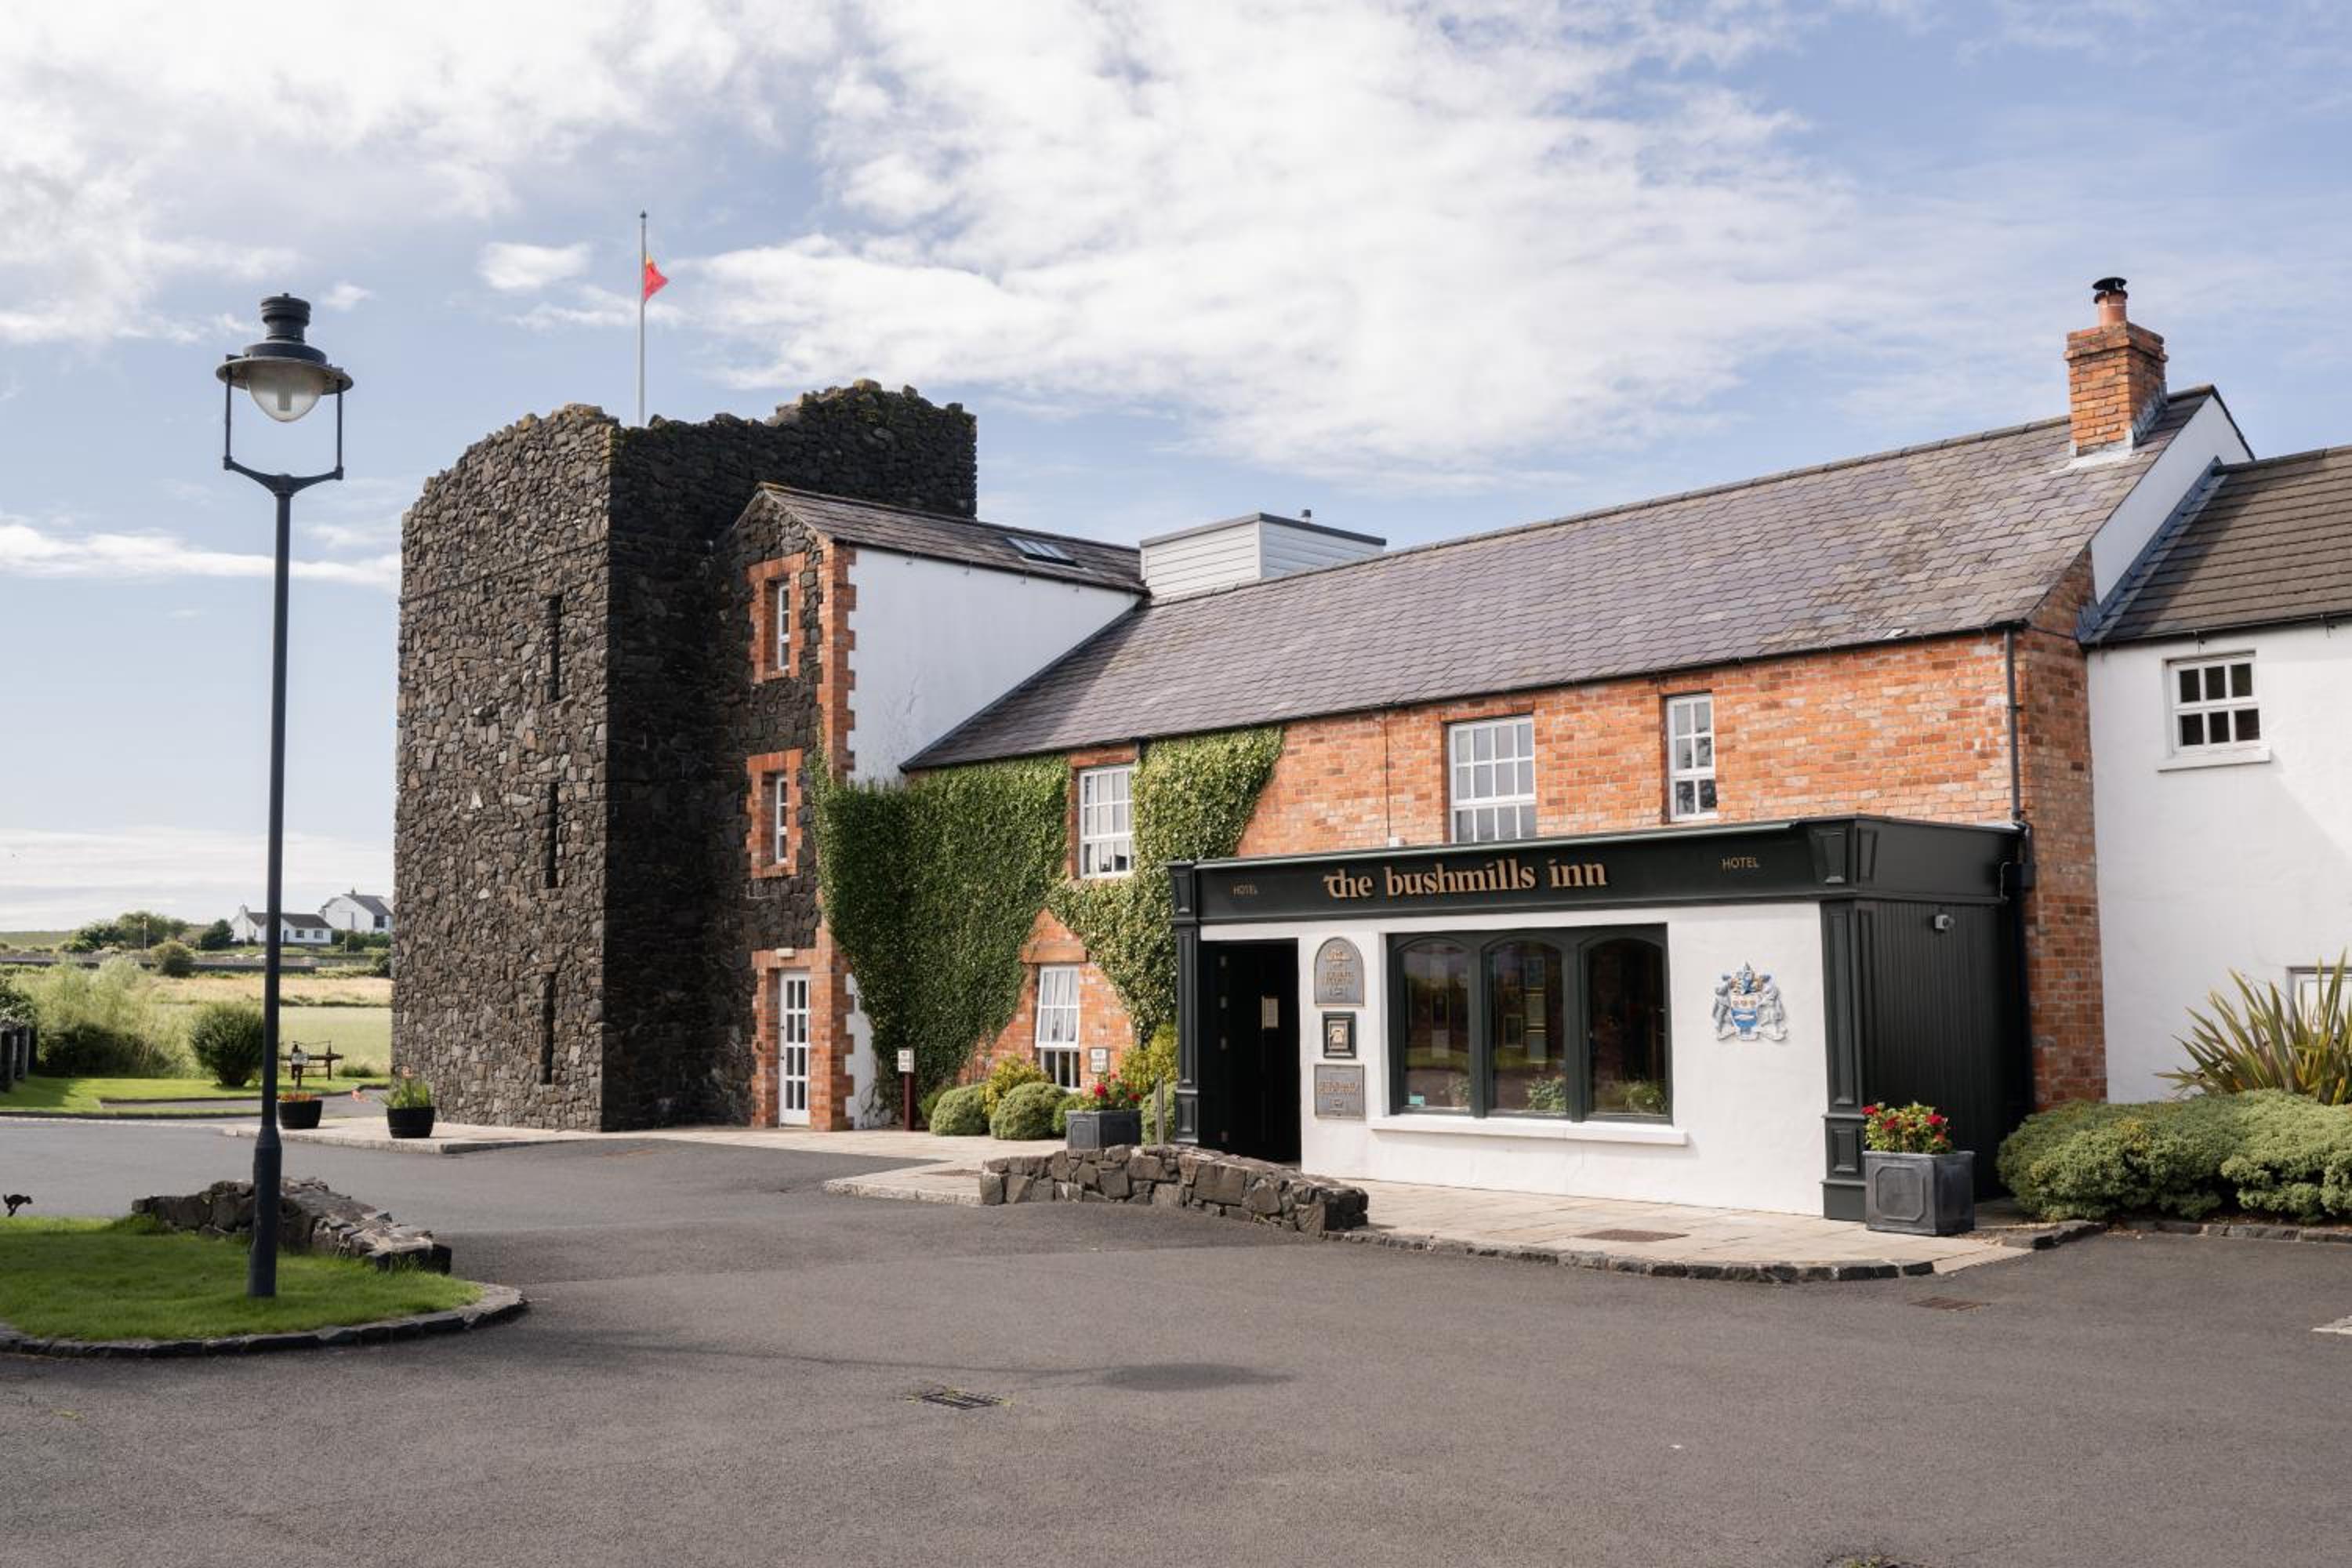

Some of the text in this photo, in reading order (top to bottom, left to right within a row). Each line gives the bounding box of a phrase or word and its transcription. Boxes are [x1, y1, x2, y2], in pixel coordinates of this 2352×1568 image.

[1722, 857, 1760, 870] HOTEL
[1323, 858, 1606, 898] the bushmills inn
